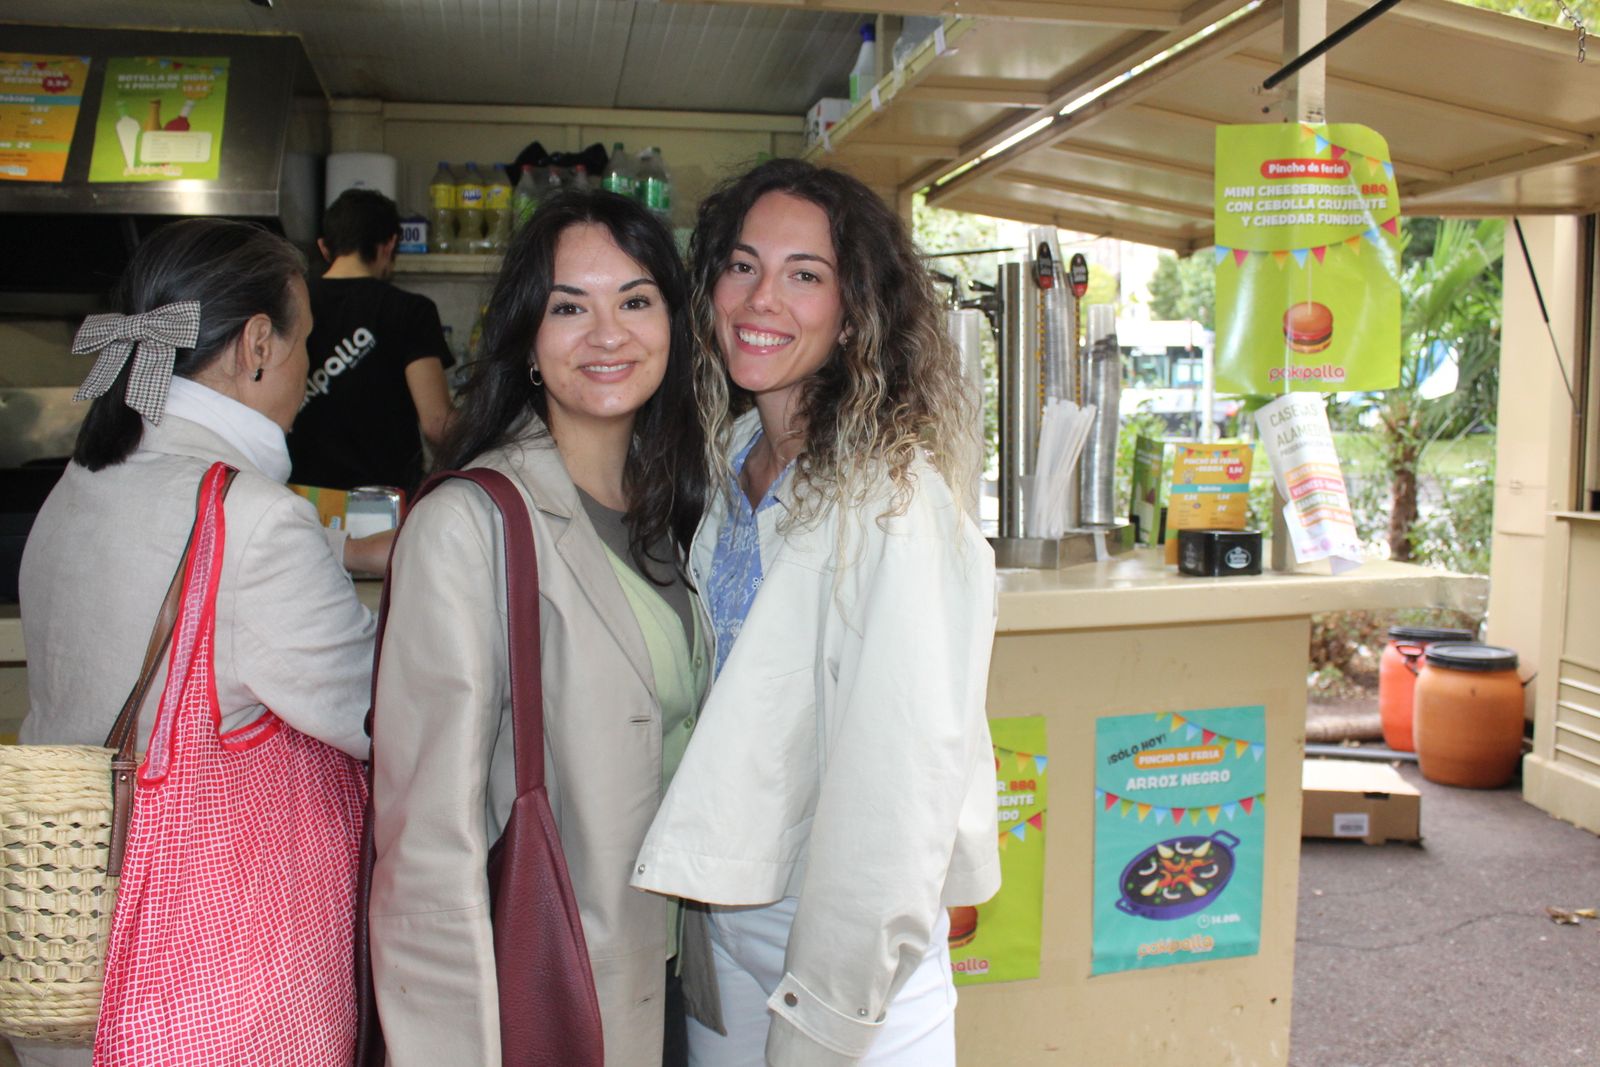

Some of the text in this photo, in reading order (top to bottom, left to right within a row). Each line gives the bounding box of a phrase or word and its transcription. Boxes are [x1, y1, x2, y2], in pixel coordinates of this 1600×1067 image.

[1268, 163, 1344, 174] Pincho de feria
[1224, 184, 1388, 198] MINI CHEESEBURGER BBQ
[1225, 198, 1387, 213] CON CEBOLLA CRUJIENTE
[1242, 213, 1372, 227] Y CHEDDAR FUNDIDO
[1140, 733, 1167, 751] HOY!
[1138, 752, 1175, 765] PINCHO
[1177, 751, 1189, 762] DE
[1010, 779, 1037, 791] BBQ
[1126, 769, 1231, 791] ARROZ NEGRO
